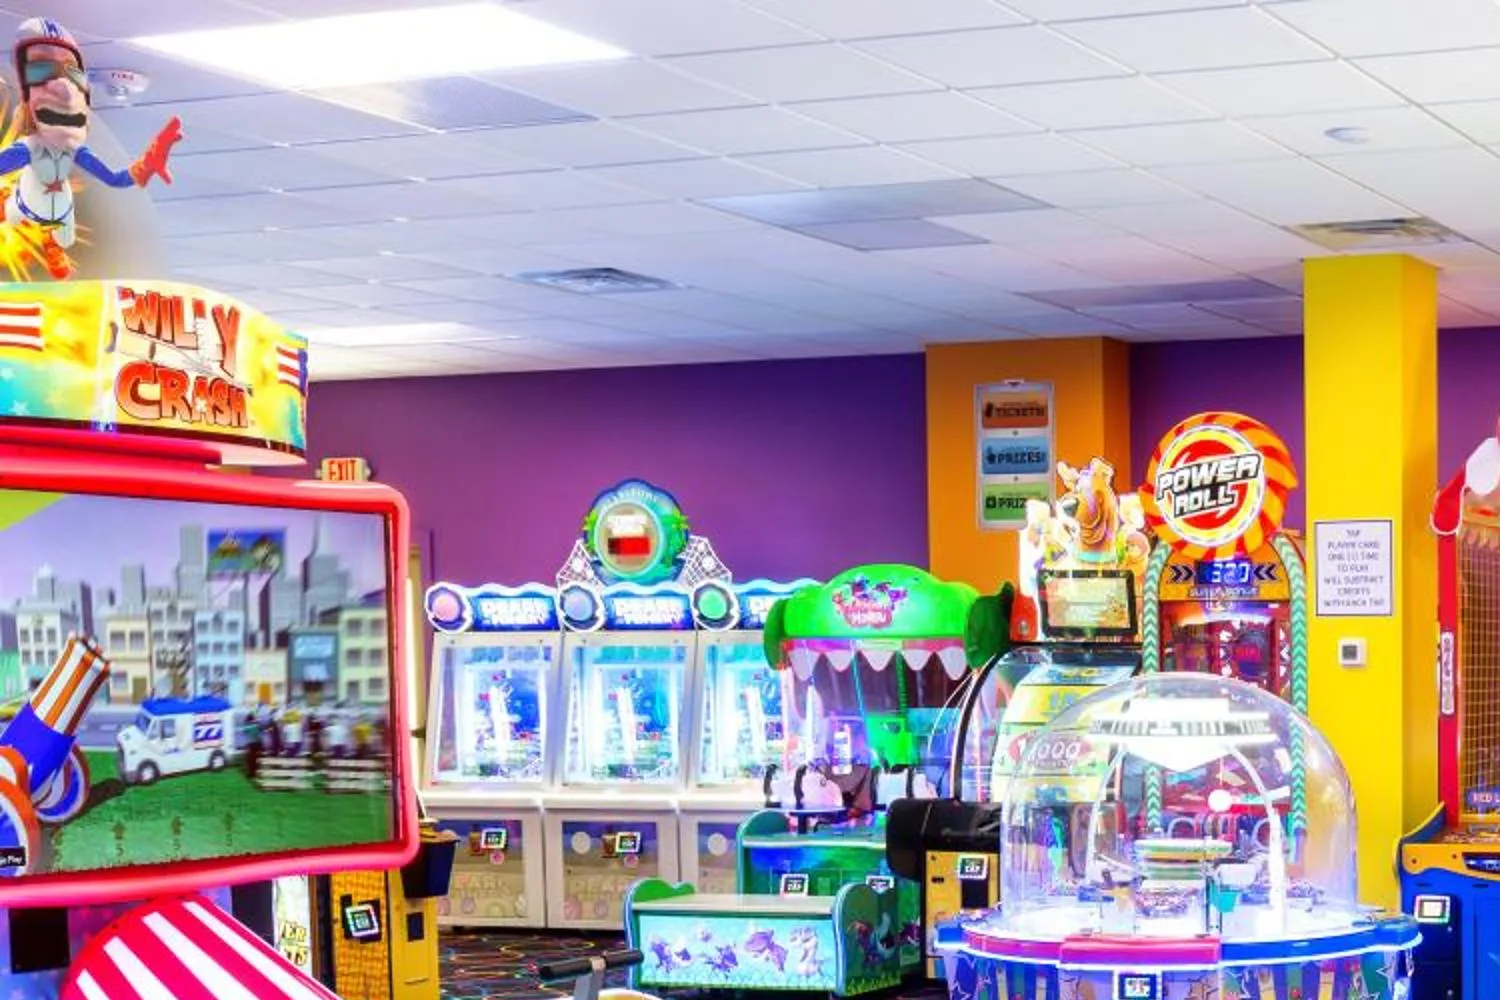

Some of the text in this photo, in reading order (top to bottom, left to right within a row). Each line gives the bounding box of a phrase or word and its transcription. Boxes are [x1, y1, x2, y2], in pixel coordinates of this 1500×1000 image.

[115, 361, 250, 428] CRASH
[326, 458, 358, 481] EXIT
[1157, 454, 1261, 501] POWER
[1174, 482, 1237, 518] ROLL
